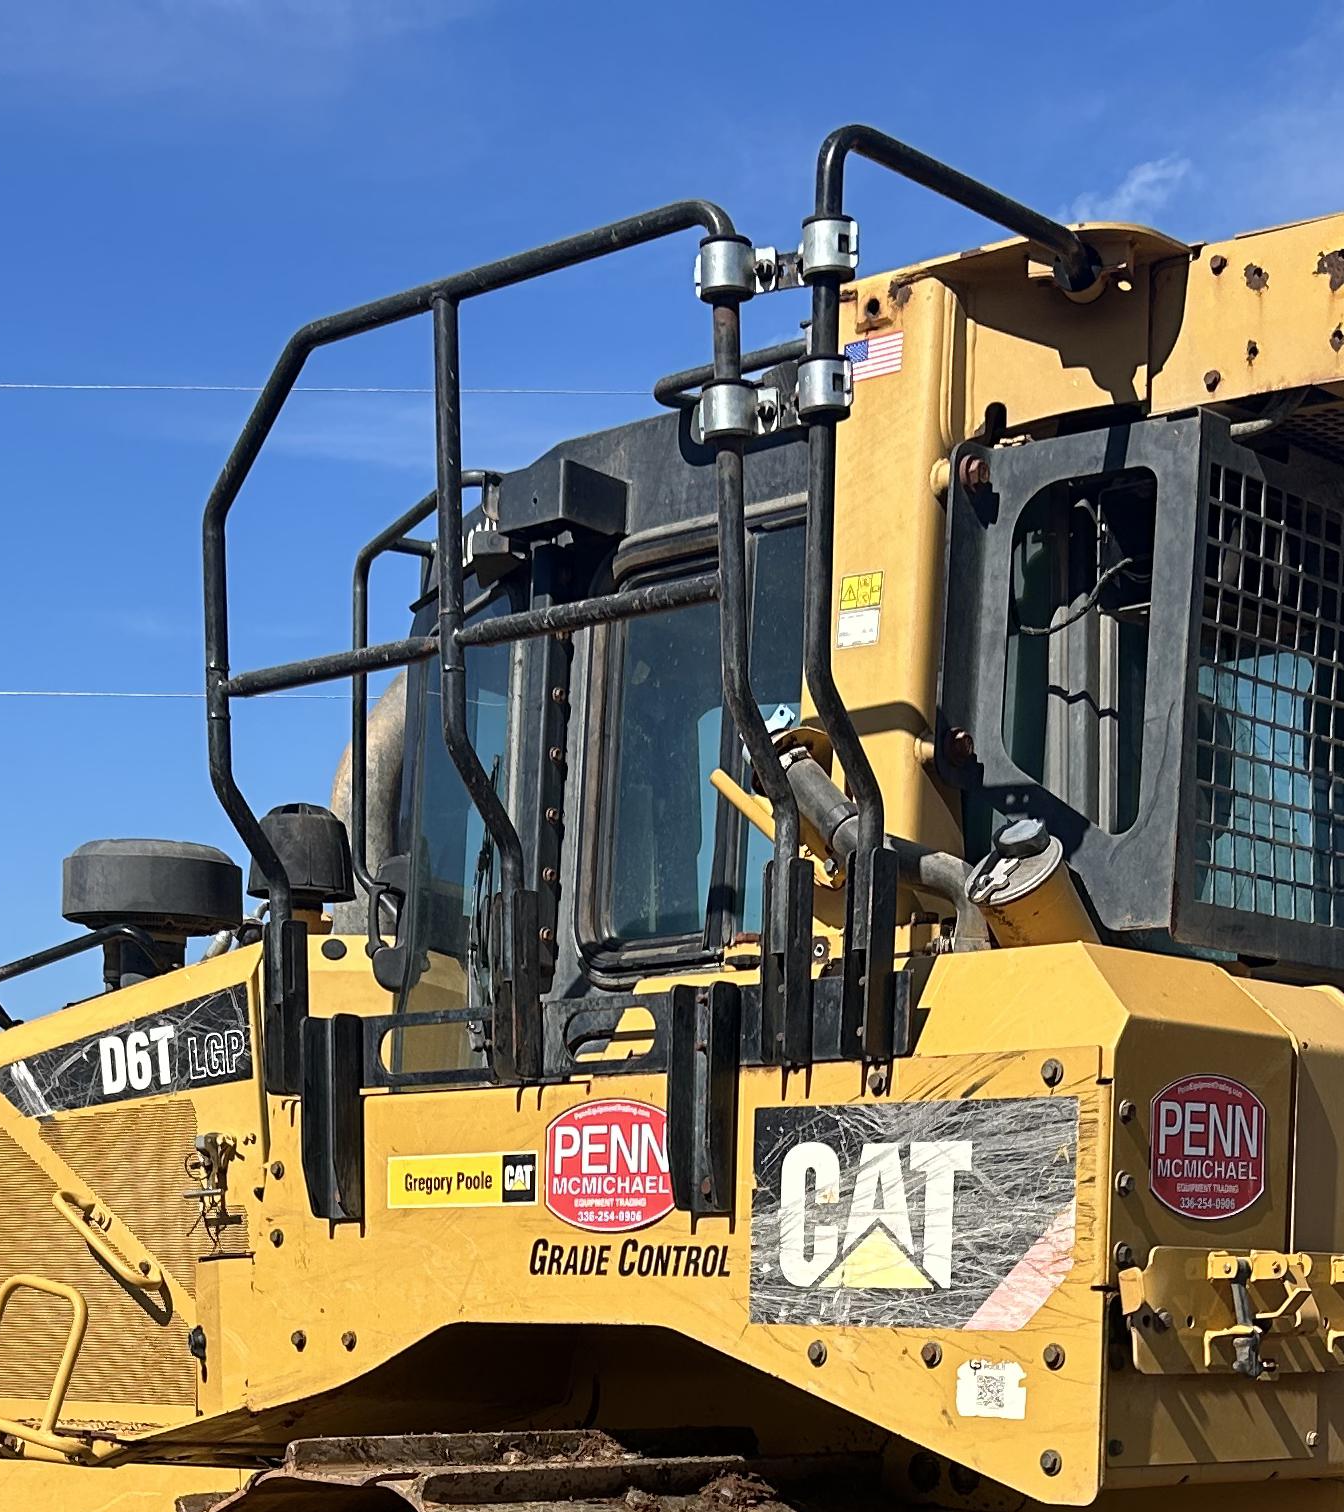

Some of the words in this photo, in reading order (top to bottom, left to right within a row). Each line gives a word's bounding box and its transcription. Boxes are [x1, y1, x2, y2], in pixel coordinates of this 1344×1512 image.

[99, 1025, 175, 1095] D6T
[187, 1030, 245, 1080] LGP
[1158, 1100, 1259, 1158] PENN
[553, 1123, 670, 1175] PENN
[404, 1173, 453, 1195] Gregory
[456, 1170, 493, 1191] Poole
[504, 1164, 534, 1191] CAT
[552, 1175, 670, 1195] MCMICHAEL
[1157, 1158, 1258, 1180] MCMICHAEL
[778, 1140, 973, 1289] CAT
[529, 1238, 612, 1276] GRADE
[618, 1238, 731, 1277] CONTROL
